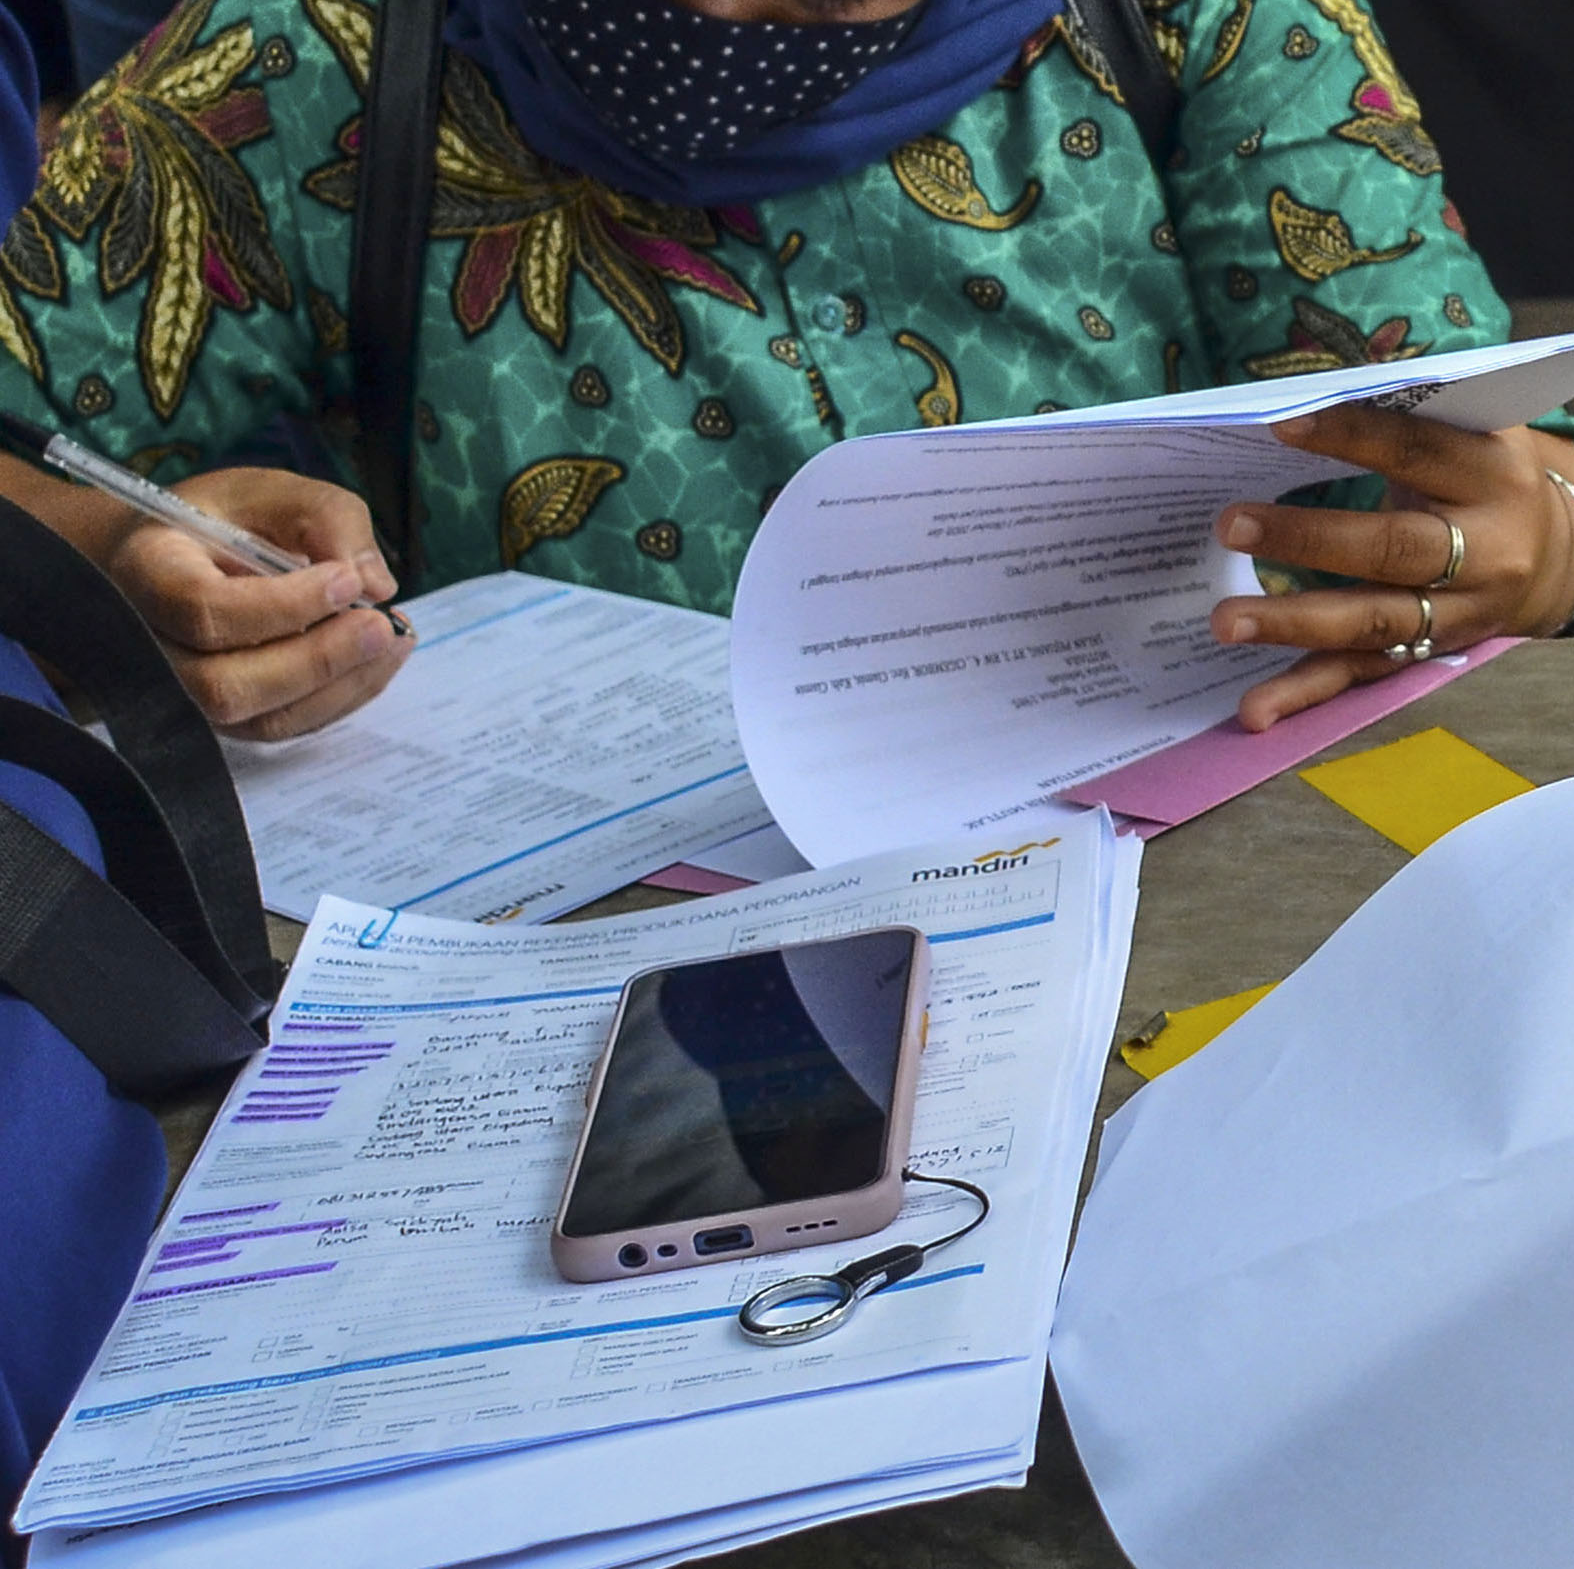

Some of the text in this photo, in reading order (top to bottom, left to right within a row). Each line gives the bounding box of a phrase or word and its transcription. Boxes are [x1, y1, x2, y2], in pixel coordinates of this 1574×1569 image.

[794, 679, 827, 699] Ciamis
[911, 854, 1030, 883] mandiri
[743, 876, 862, 914] PERORANGAN
[315, 956, 375, 970] CABANG
